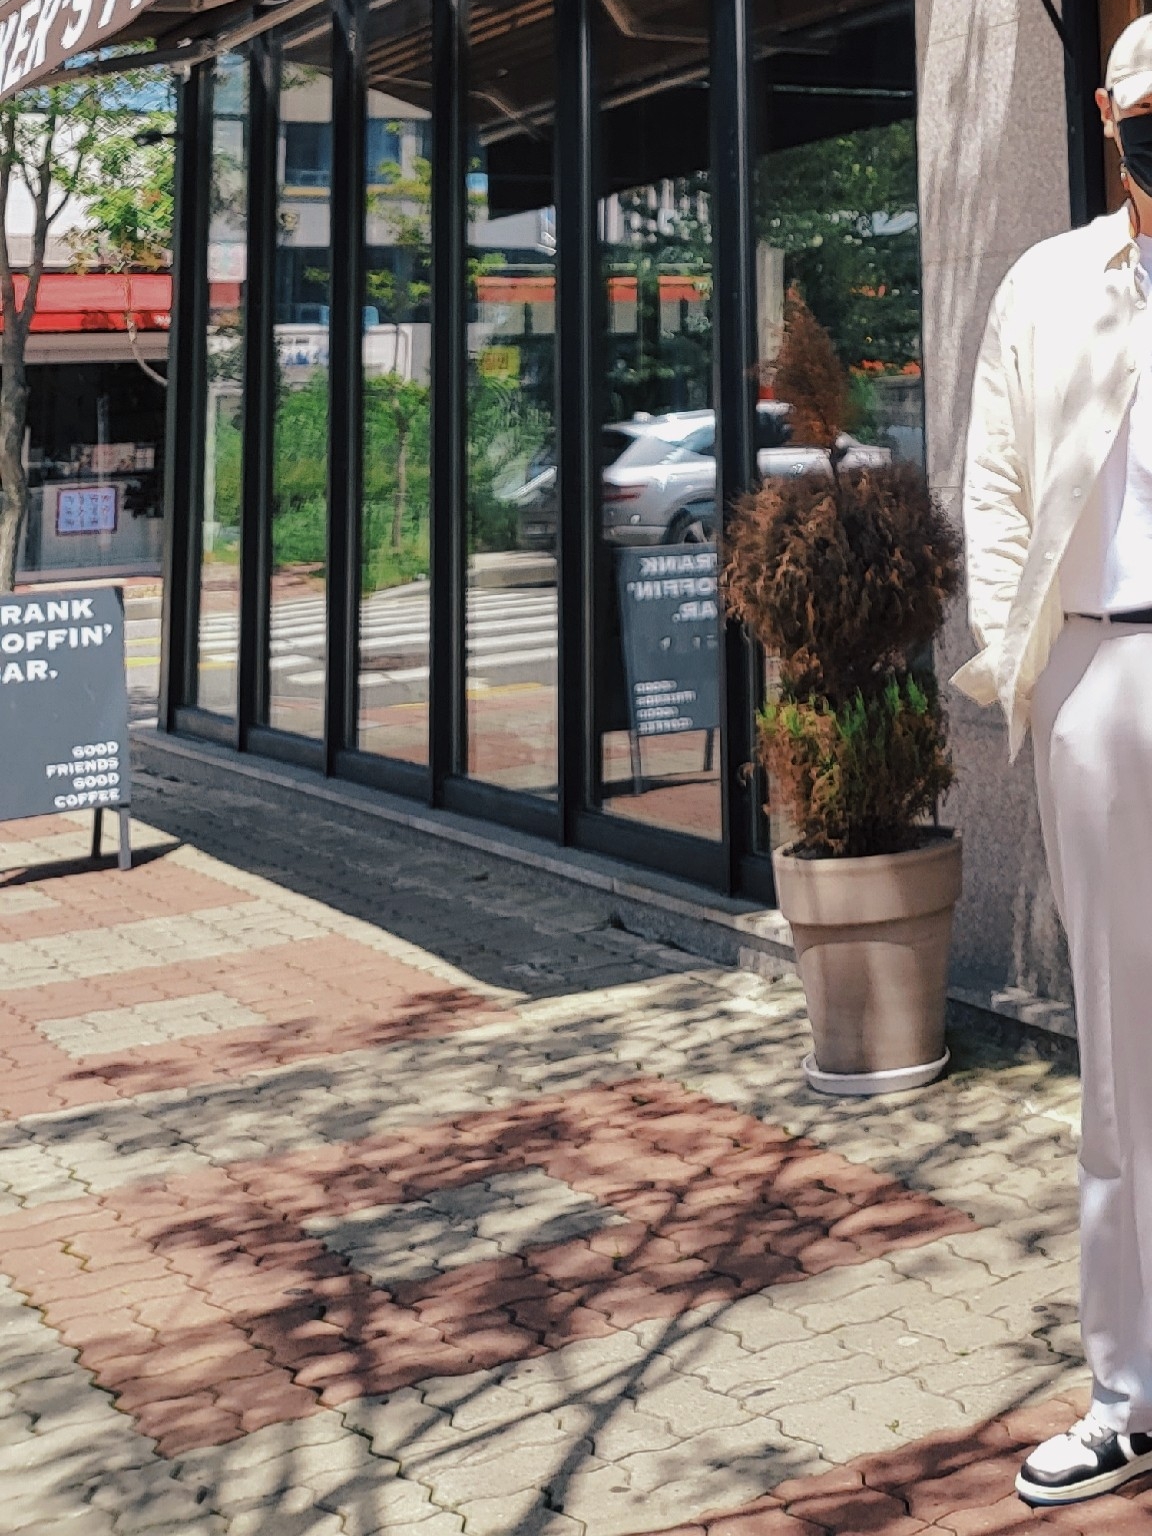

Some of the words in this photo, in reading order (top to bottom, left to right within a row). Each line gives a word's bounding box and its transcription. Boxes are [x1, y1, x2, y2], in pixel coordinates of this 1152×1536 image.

[0, 597, 95, 626] RANK
[72, 740, 119, 759] GOOD
[45, 756, 119, 779] FRIENDS
[72, 771, 120, 791] GOOD
[54, 787, 121, 809] COFFEE
